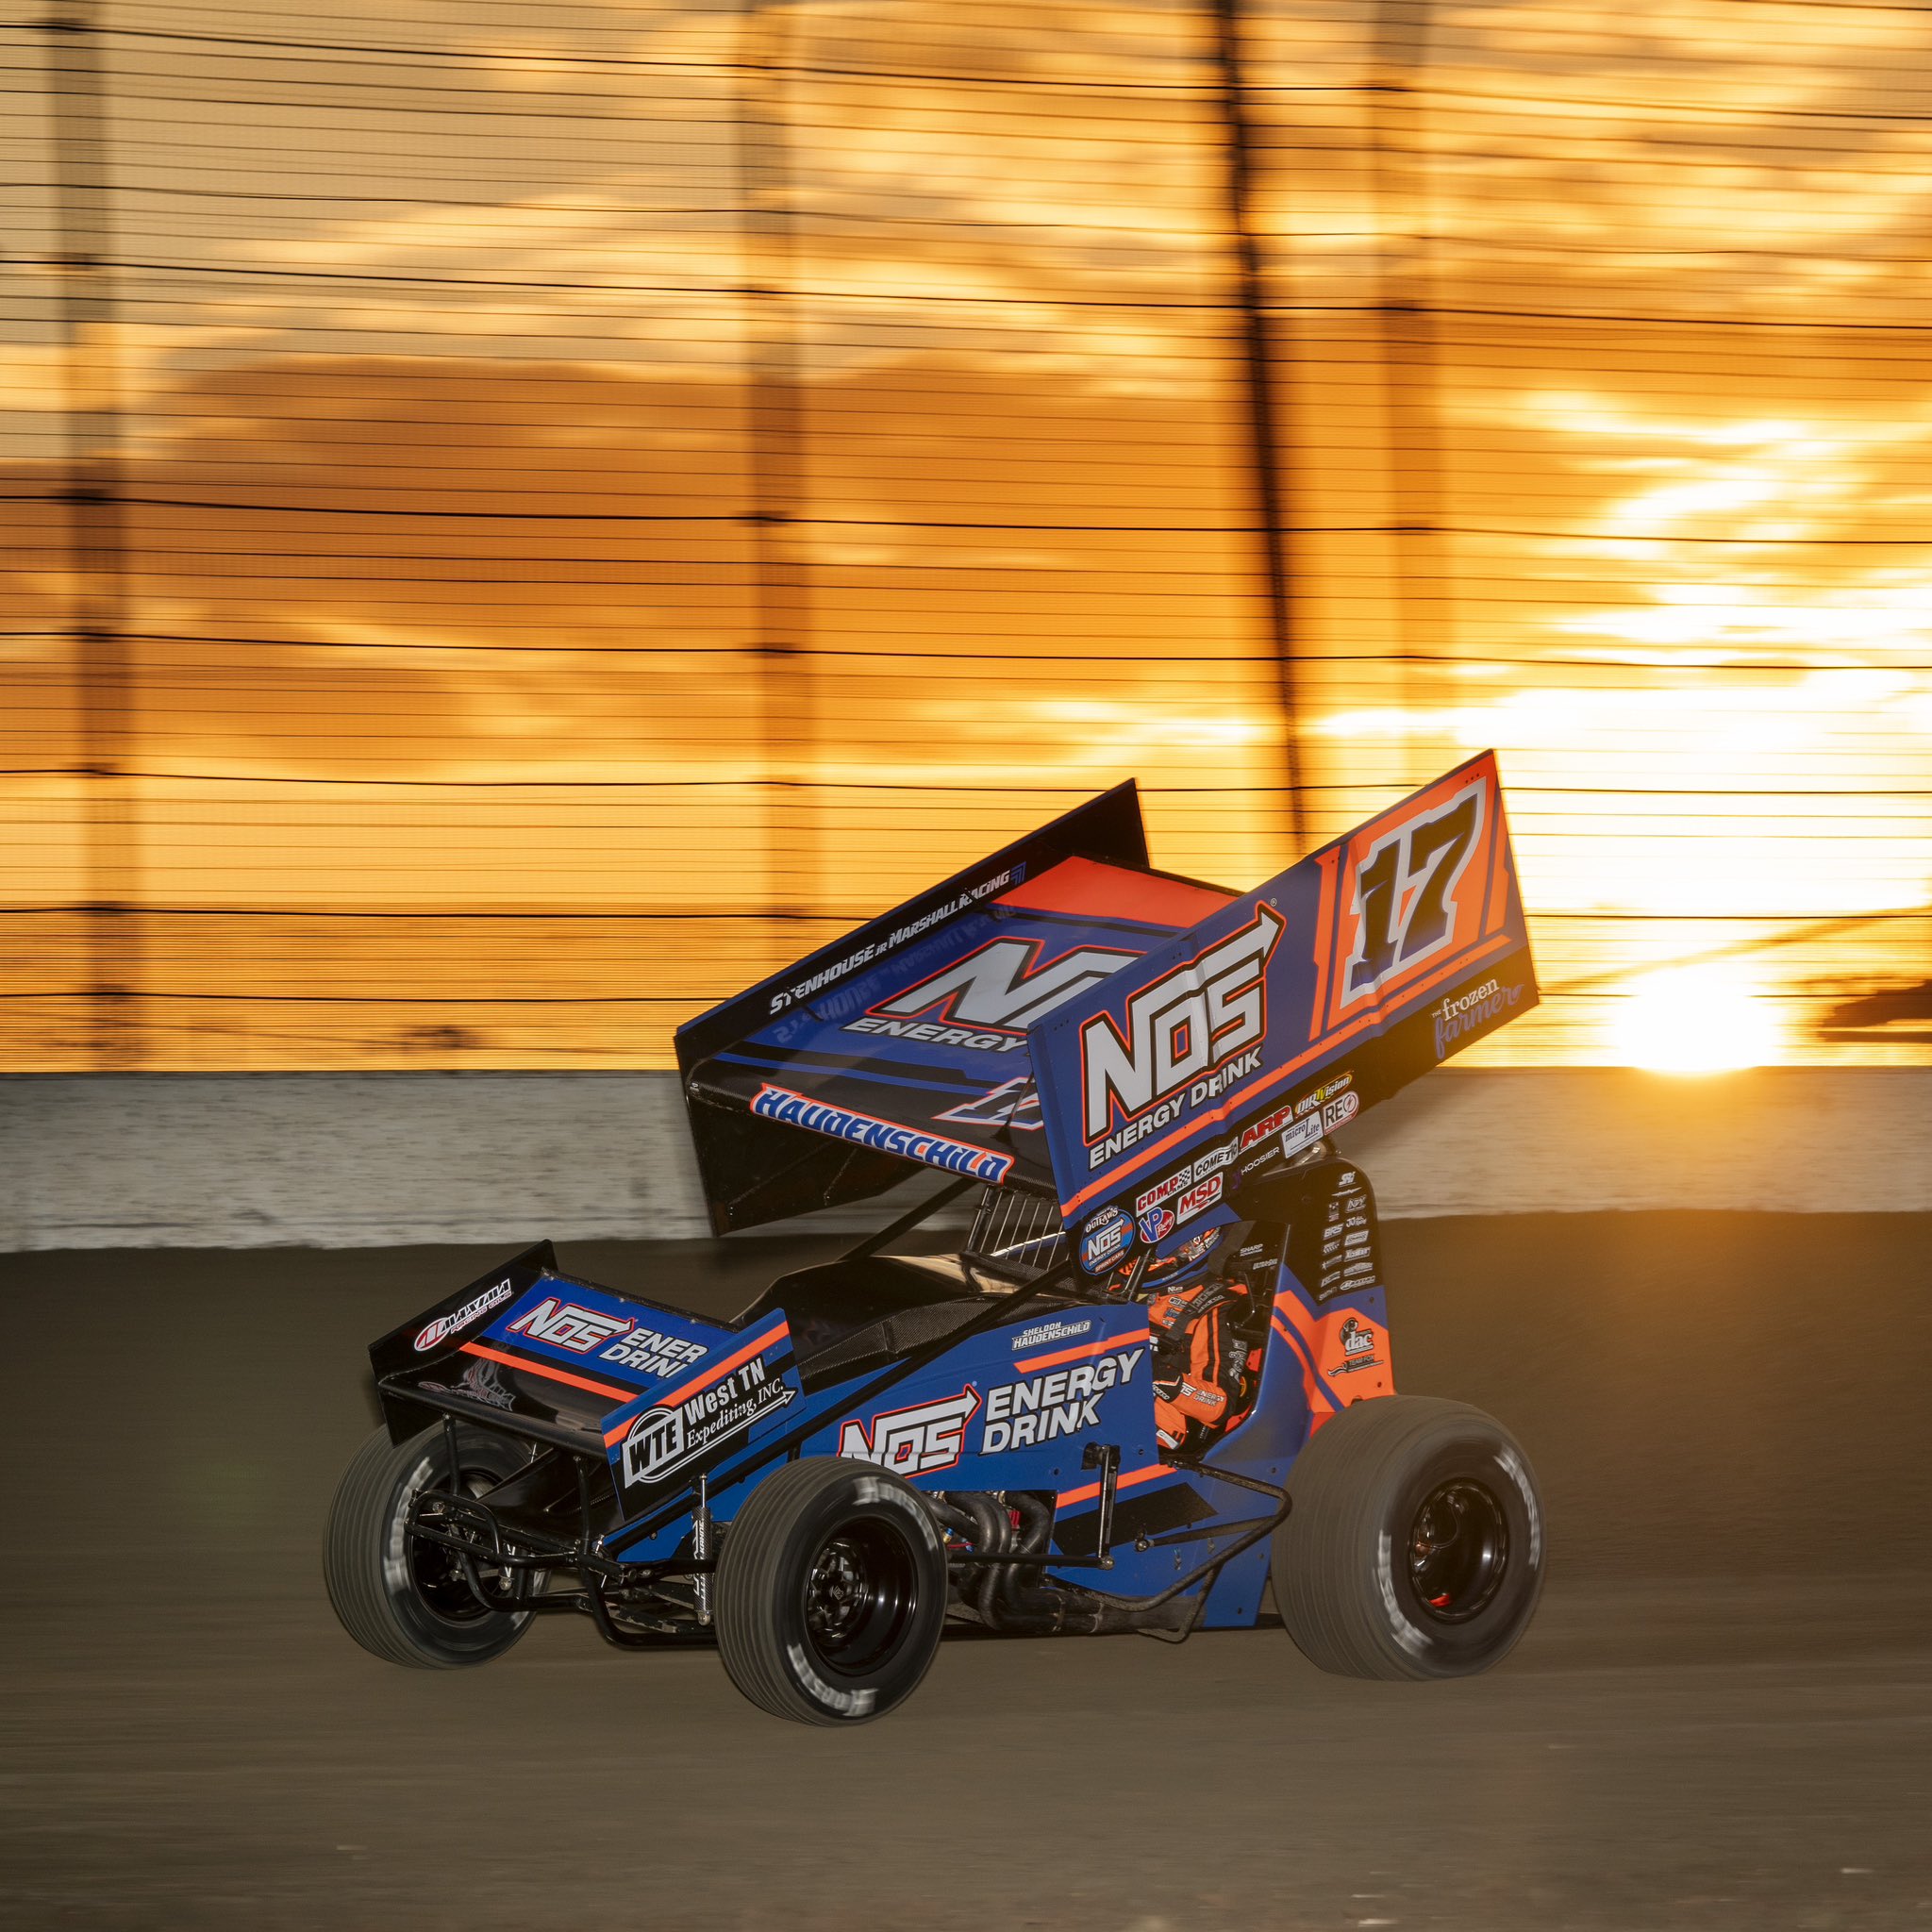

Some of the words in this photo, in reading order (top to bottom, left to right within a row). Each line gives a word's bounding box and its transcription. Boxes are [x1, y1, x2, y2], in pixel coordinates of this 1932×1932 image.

[1340, 776, 1486, 1008] 17
[769, 943, 874, 1015] STENHOUSE
[889, 901, 958, 948] MARSHALL
[958, 870, 1010, 909] RACING
[1086, 911, 1279, 1136] NOS
[1431, 1009, 1441, 1018] THE
[1442, 978, 1500, 1021] frozen
[1435, 984, 1524, 1059] farmer
[839, 1017, 1027, 1052] ENERGY
[1090, 1094, 1185, 1170] ENERGY
[1191, 1046, 1262, 1108] DRINK
[1241, 1107, 1291, 1148] ARP
[754, 1089, 1008, 1183] HAUDENSCHILD
[1241, 1146, 1280, 1175] HOOSIER
[1137, 1176, 1179, 1212] COMP
[1179, 1175, 1222, 1216] MSD
[1088, 1218, 1124, 1261] NOS
[1139, 1207, 1163, 1242] VP
[508, 1298, 633, 1353] NOS
[620, 1327, 708, 1363] ENER
[1013, 1321, 1091, 1349] HAUDENSCHILD
[1023, 1322, 1061, 1337] SHELDON
[1345, 1331, 1374, 1351] dac
[684, 1376, 738, 1425] West
[739, 1357, 766, 1391] TN
[687, 1397, 758, 1449] Expediting,
[758, 1377, 784, 1404] INC.
[985, 1349, 1141, 1423] ENERGY
[629, 1416, 678, 1477] WTE
[841, 1389, 980, 1474] NOS
[981, 1392, 1105, 1456] DRINK
